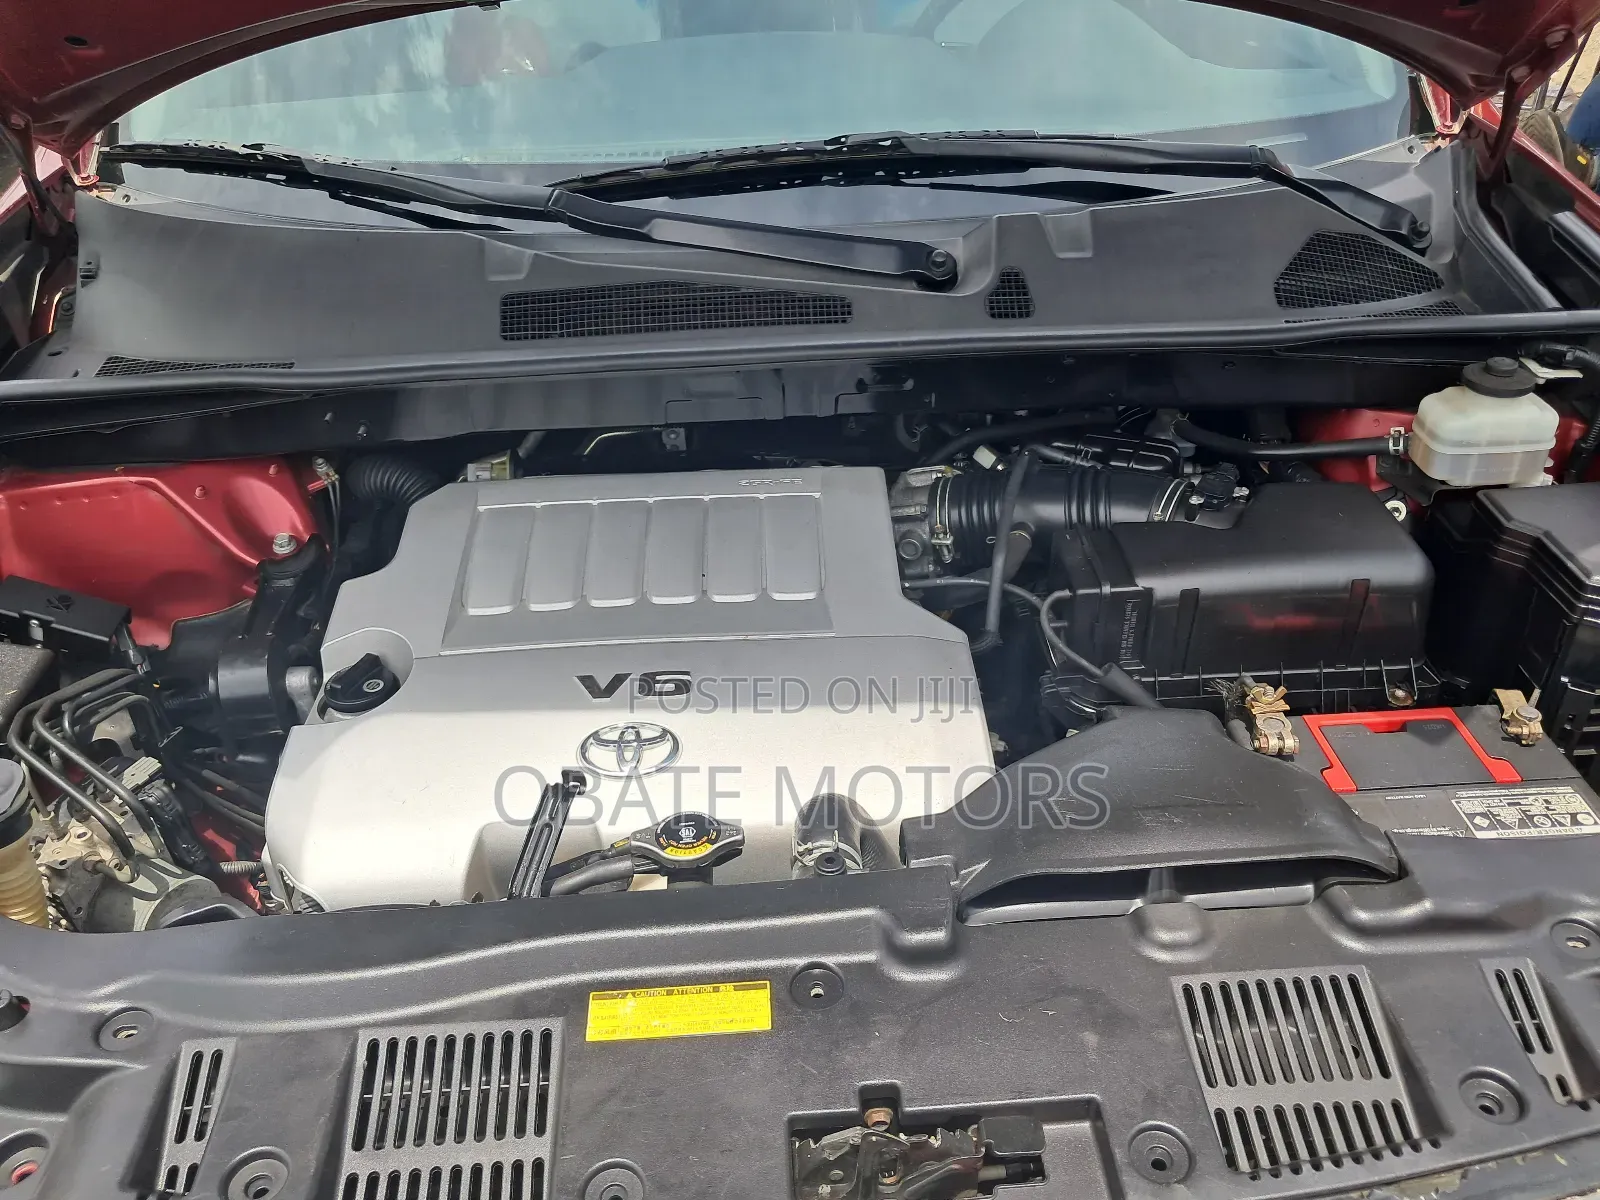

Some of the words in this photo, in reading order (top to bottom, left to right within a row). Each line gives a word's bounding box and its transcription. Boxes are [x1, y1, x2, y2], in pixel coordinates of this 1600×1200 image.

[574, 671, 693, 701] V6
[634, 989, 667, 998] CAUTION
[672, 986, 714, 996] ATTENTION
